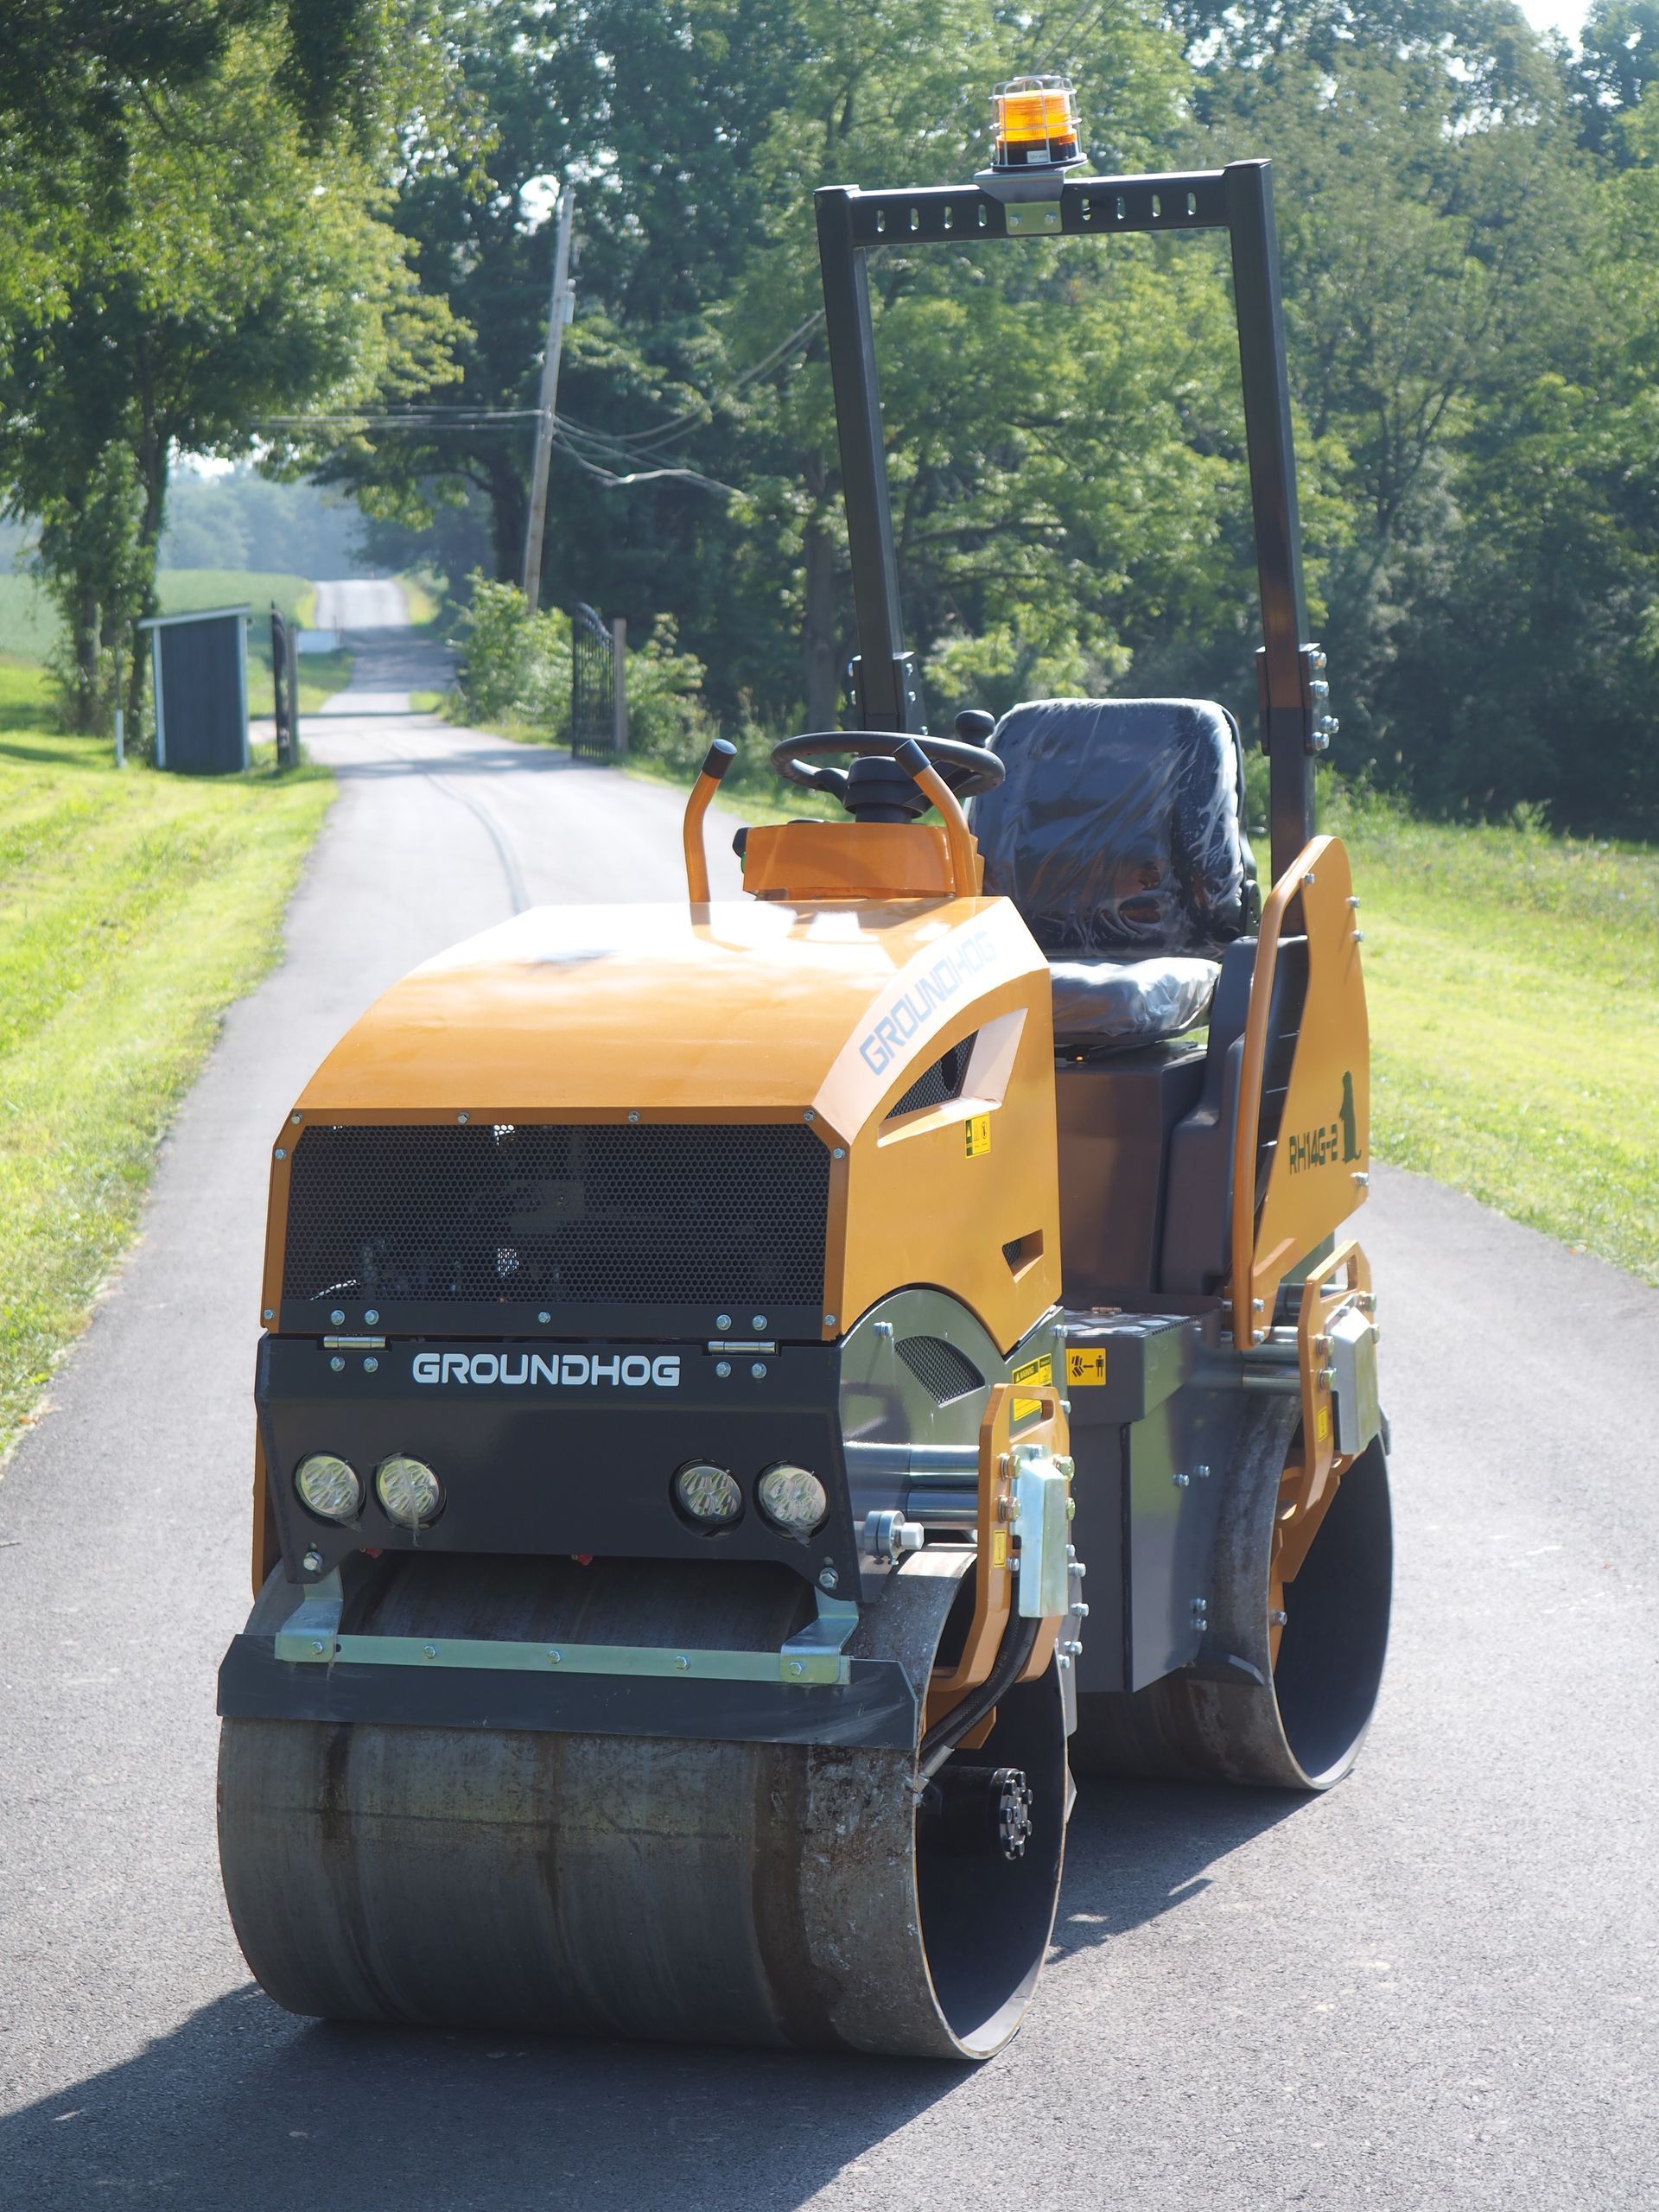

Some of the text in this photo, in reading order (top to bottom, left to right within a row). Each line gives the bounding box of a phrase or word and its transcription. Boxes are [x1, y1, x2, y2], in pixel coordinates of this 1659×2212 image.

[859, 931, 996, 1075] GROUNDHOG
[1289, 1123, 1338, 1175] RH14G-2
[413, 1353, 680, 1386] GROUNDHOG
